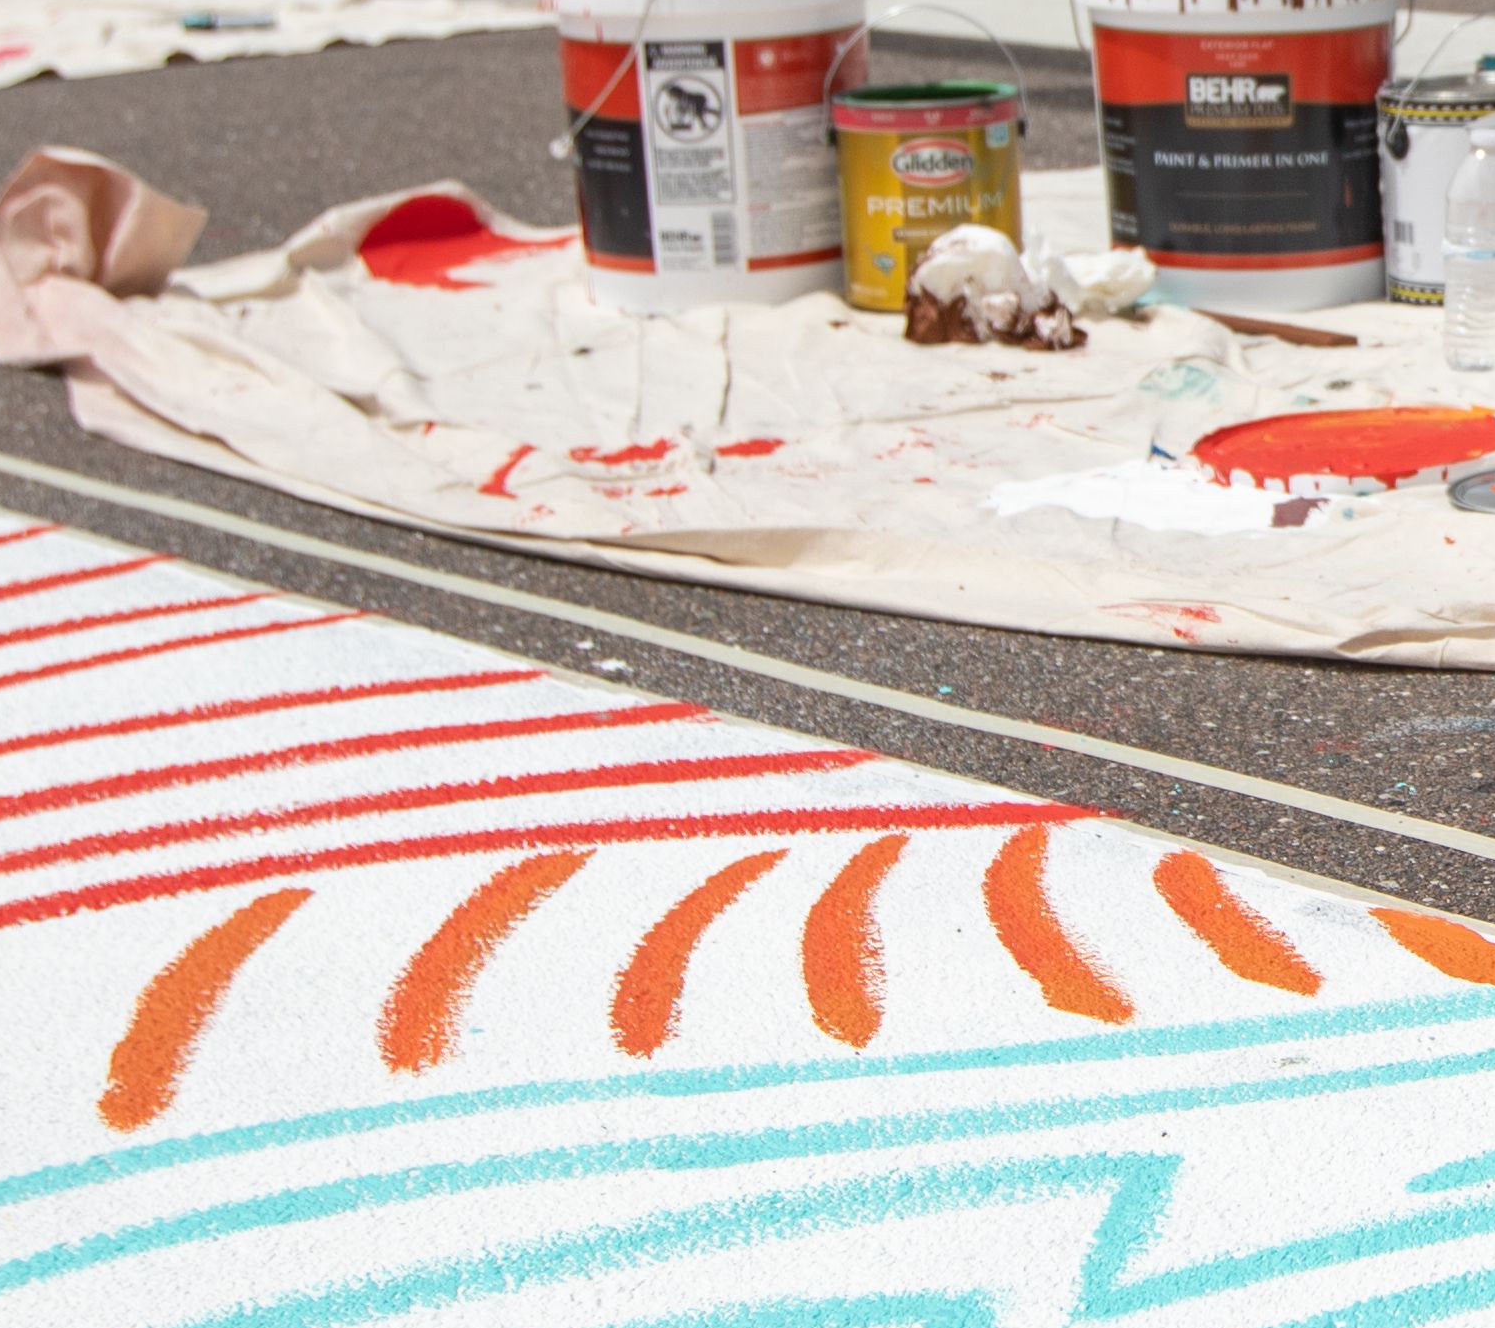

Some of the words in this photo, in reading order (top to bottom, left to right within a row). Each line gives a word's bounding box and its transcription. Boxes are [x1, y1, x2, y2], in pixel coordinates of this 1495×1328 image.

[1189, 76, 1256, 104] BEHR
[892, 151, 974, 173] Glidden
[1154, 151, 1195, 169] PAINT
[1197, 153, 1211, 170] &
[1213, 153, 1272, 170] PRIMER
[1275, 153, 1294, 168] IN
[1296, 150, 1330, 167] ONE
[866, 190, 1004, 218] PREMIUM
